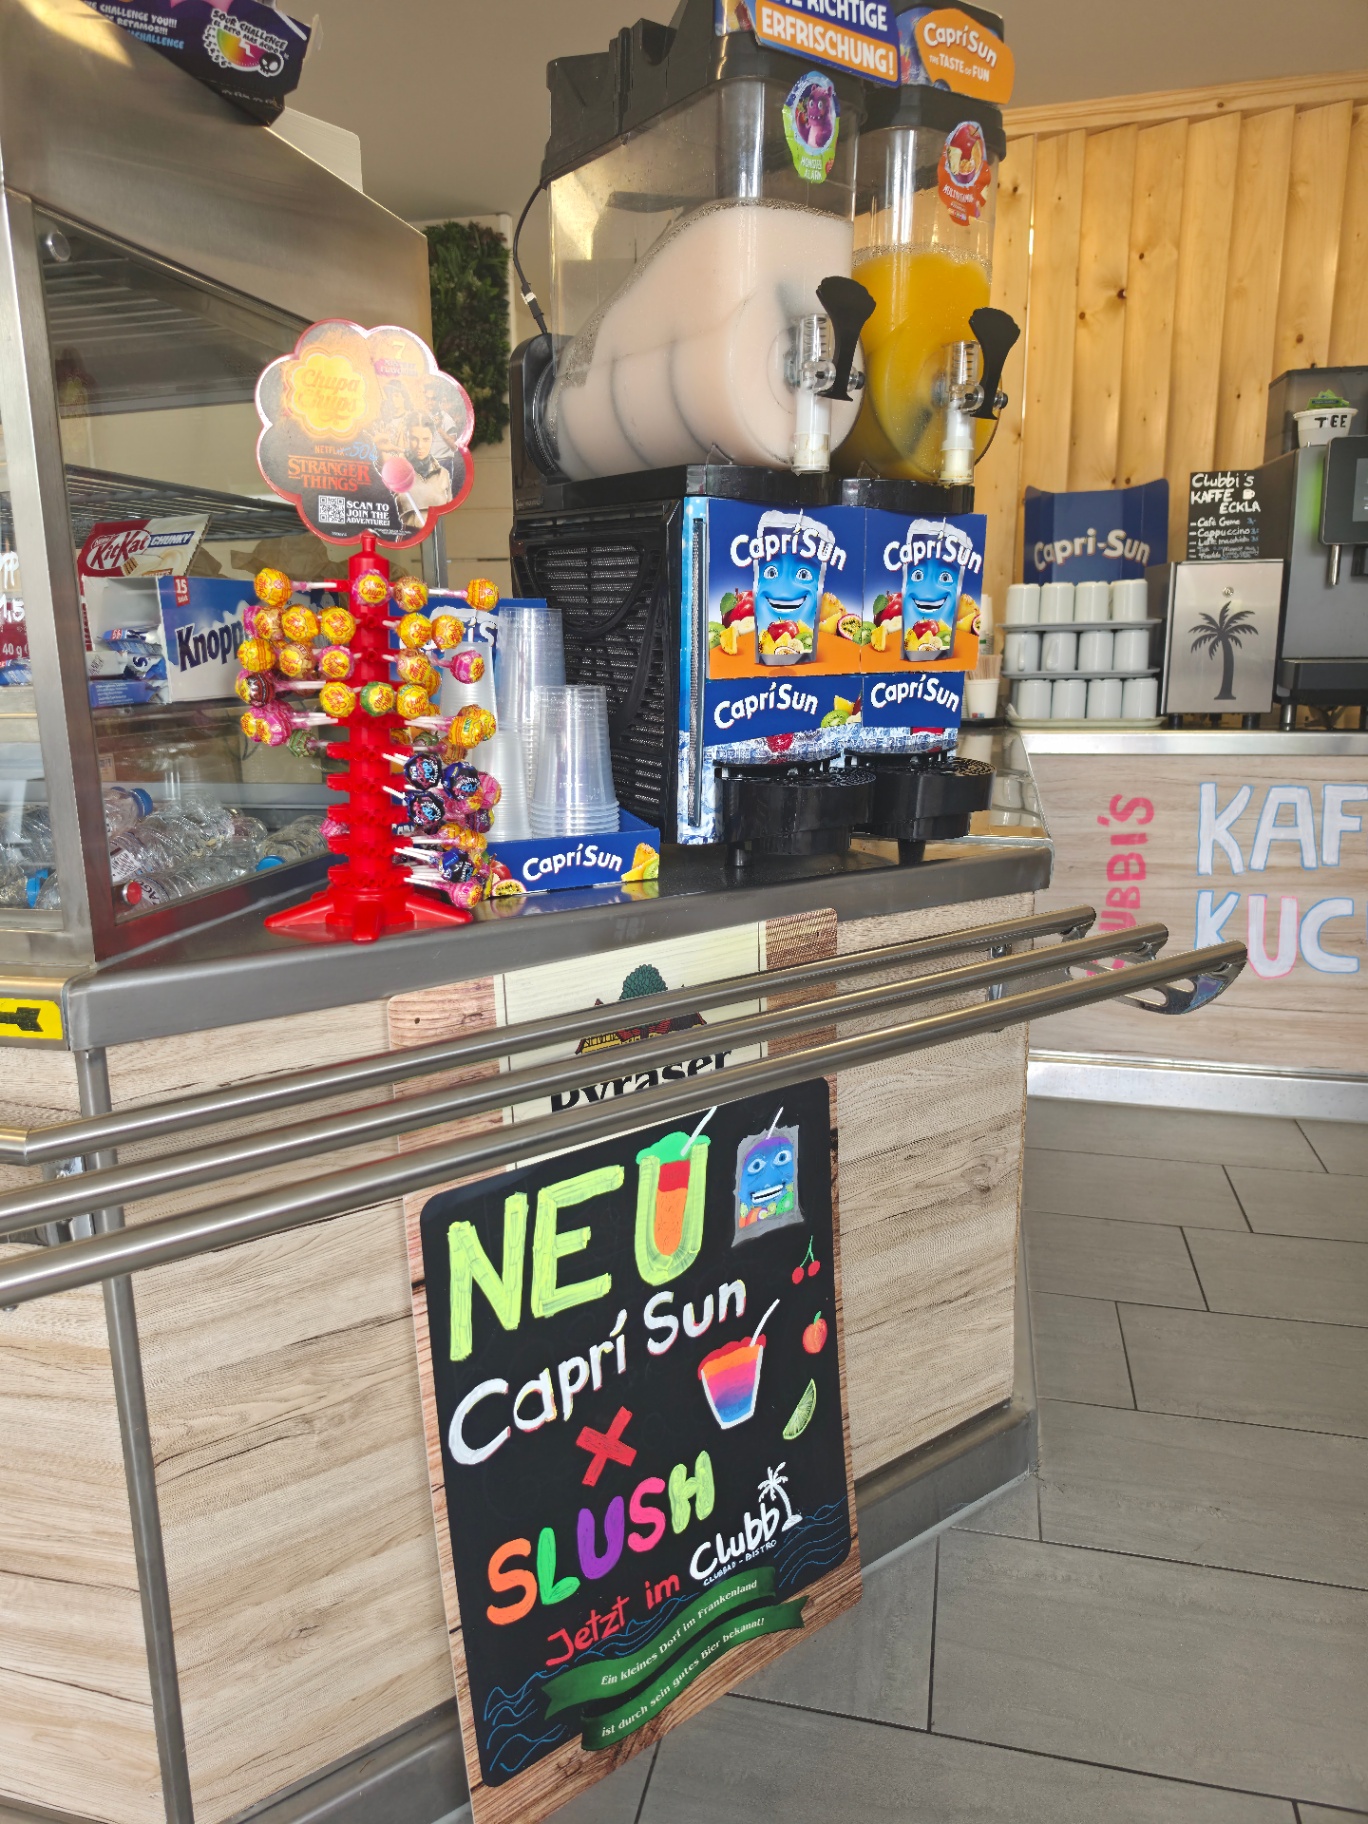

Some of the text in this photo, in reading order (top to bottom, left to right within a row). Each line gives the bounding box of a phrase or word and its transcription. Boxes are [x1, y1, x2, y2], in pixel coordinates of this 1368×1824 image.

[100, 4, 149, 22] CHALLENGE
[212, 10, 287, 50] SOUR CHALLENGE
[761, 7, 894, 75] ERFRISCHUNG!
[939, 53, 965, 74] TASTE
[972, 65, 990, 82] FUN
[392, 341, 406, 360] 7
[301, 368, 361, 396] Chupa
[298, 387, 357, 413] Chups
[1314, 414, 1348, 429] TEE
[288, 458, 371, 486] STRANGER
[301, 474, 359, 492] THINGS
[346, 500, 390, 512] SCAN TO
[1190, 488, 1235, 505] KAFFE
[1219, 501, 1261, 514] ECKLA
[346, 509, 390, 520] JOIN THE
[346, 517, 390, 527] ADVENTURE!
[89, 531, 192, 570] KitKat CHUNKY
[175, 579, 188, 594] 15
[176, 626, 245, 672] Knopp
[447, 1138, 710, 1362] NEU
[644, 1279, 747, 1355] Sun
[486, 1450, 716, 1626] SLUSH
[745, 1540, 777, 1562] BISTRO
[546, 1573, 681, 1667] Jetzt im
[601, 1579, 758, 1686] Ein kleines Dorf im Frankenland
[601, 1618, 765, 1738] ist durch sein gutes Bier bekannt!
